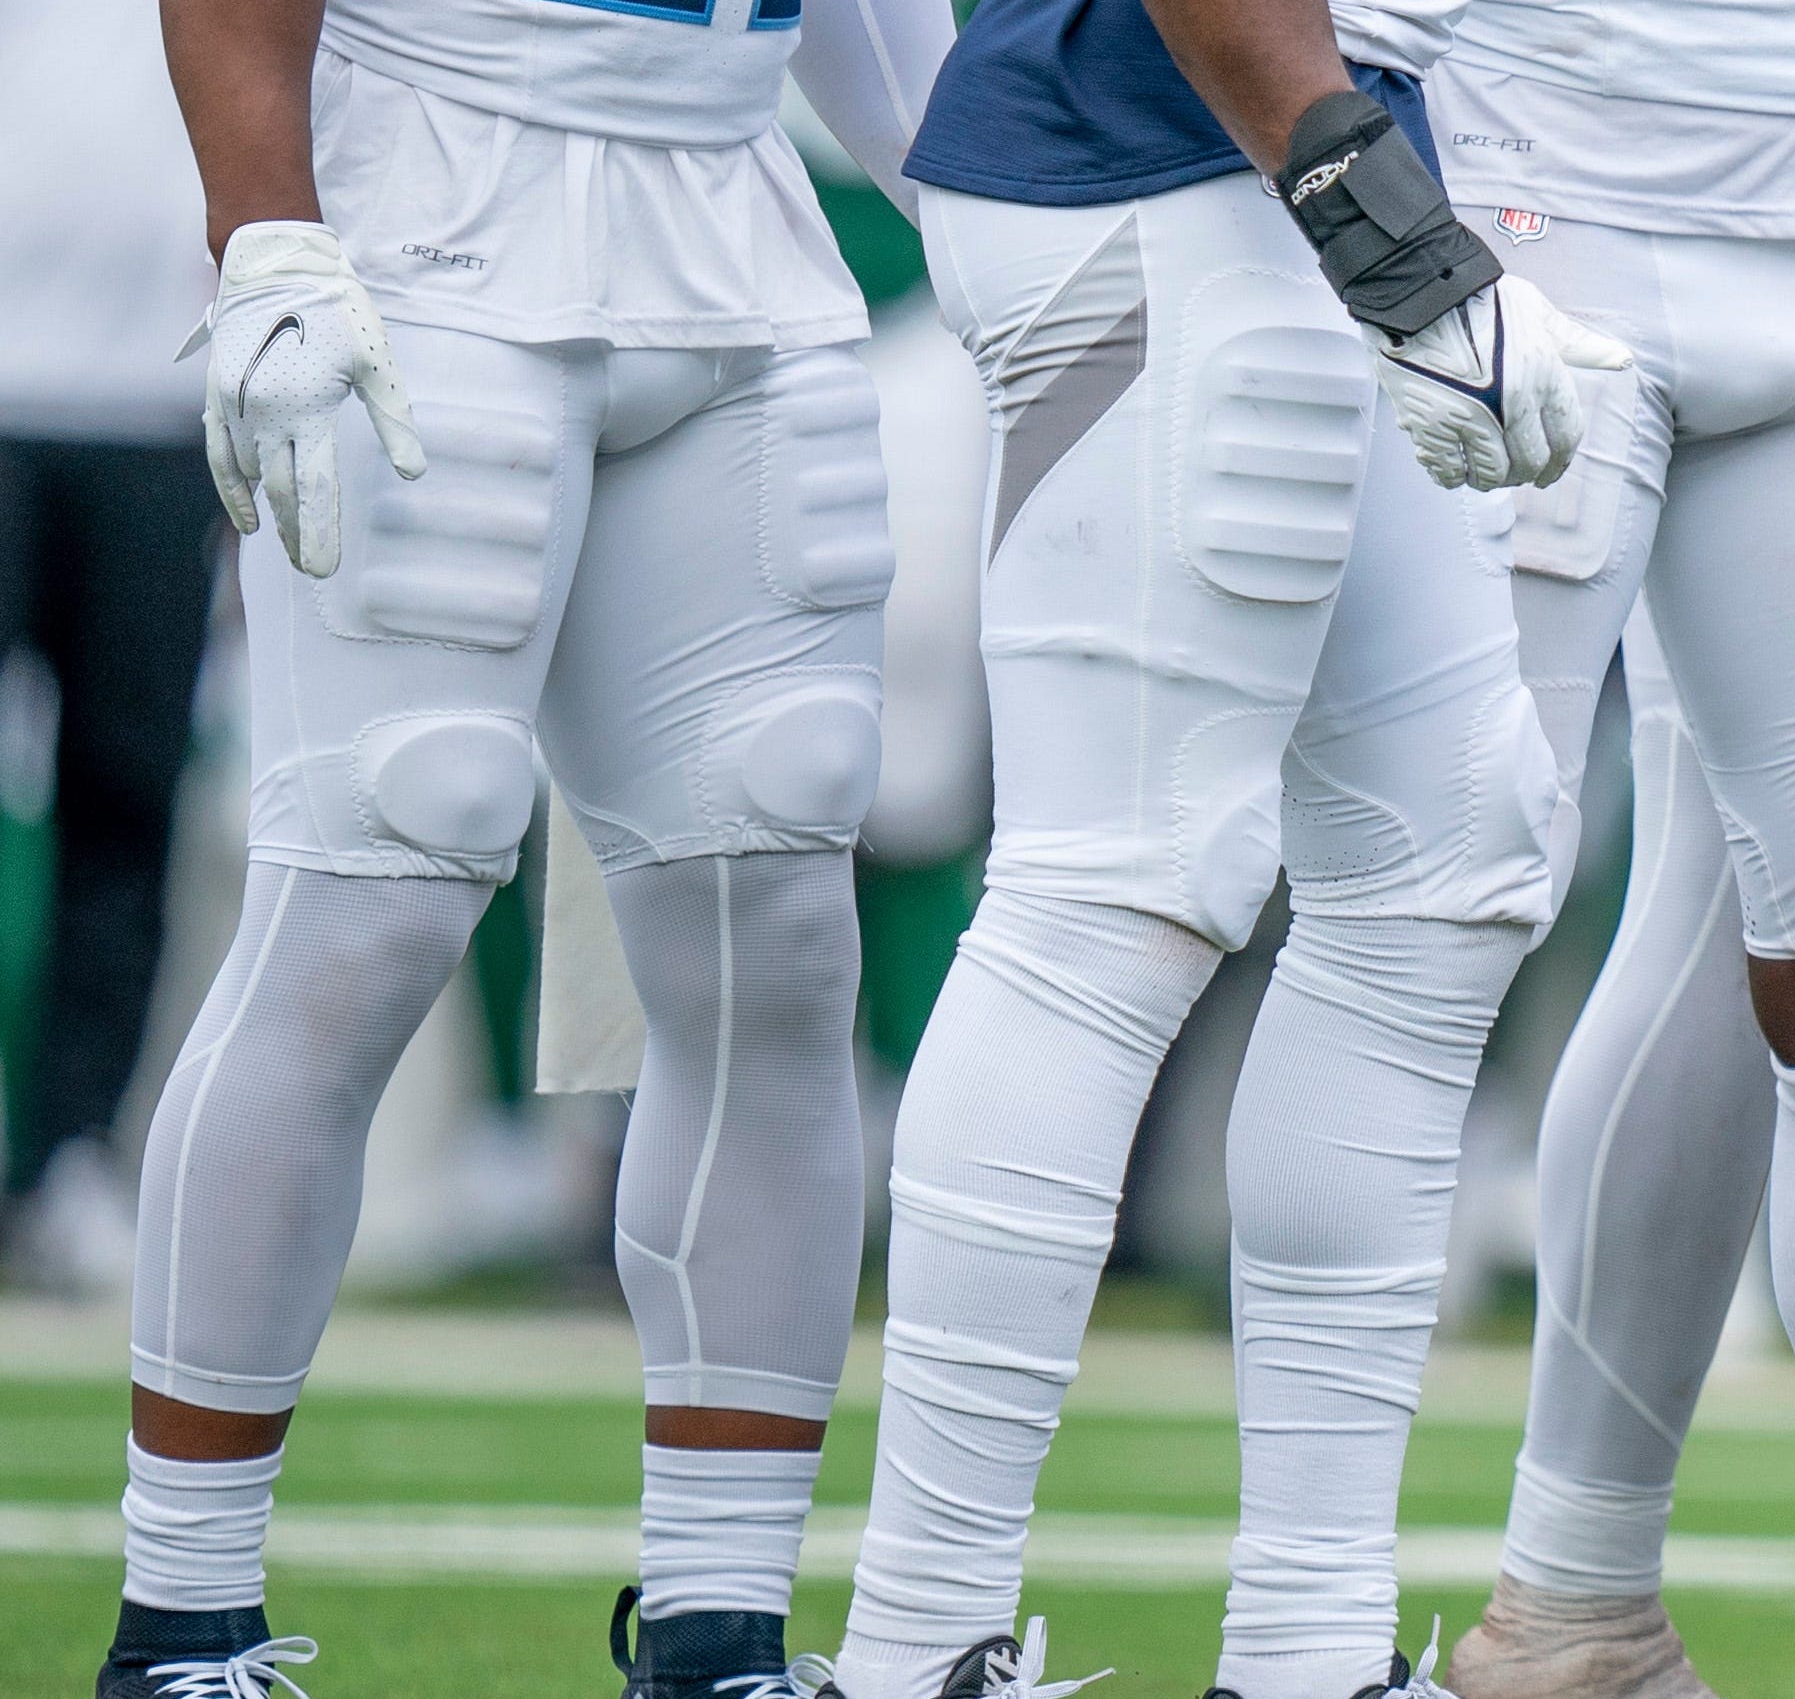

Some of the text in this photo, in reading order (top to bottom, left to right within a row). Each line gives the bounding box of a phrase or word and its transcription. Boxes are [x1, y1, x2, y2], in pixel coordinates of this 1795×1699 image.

[1453, 132, 1537, 152] DRI-FIT
[1500, 208, 1541, 231] NFL
[402, 244, 489, 270] DRI-FIT
